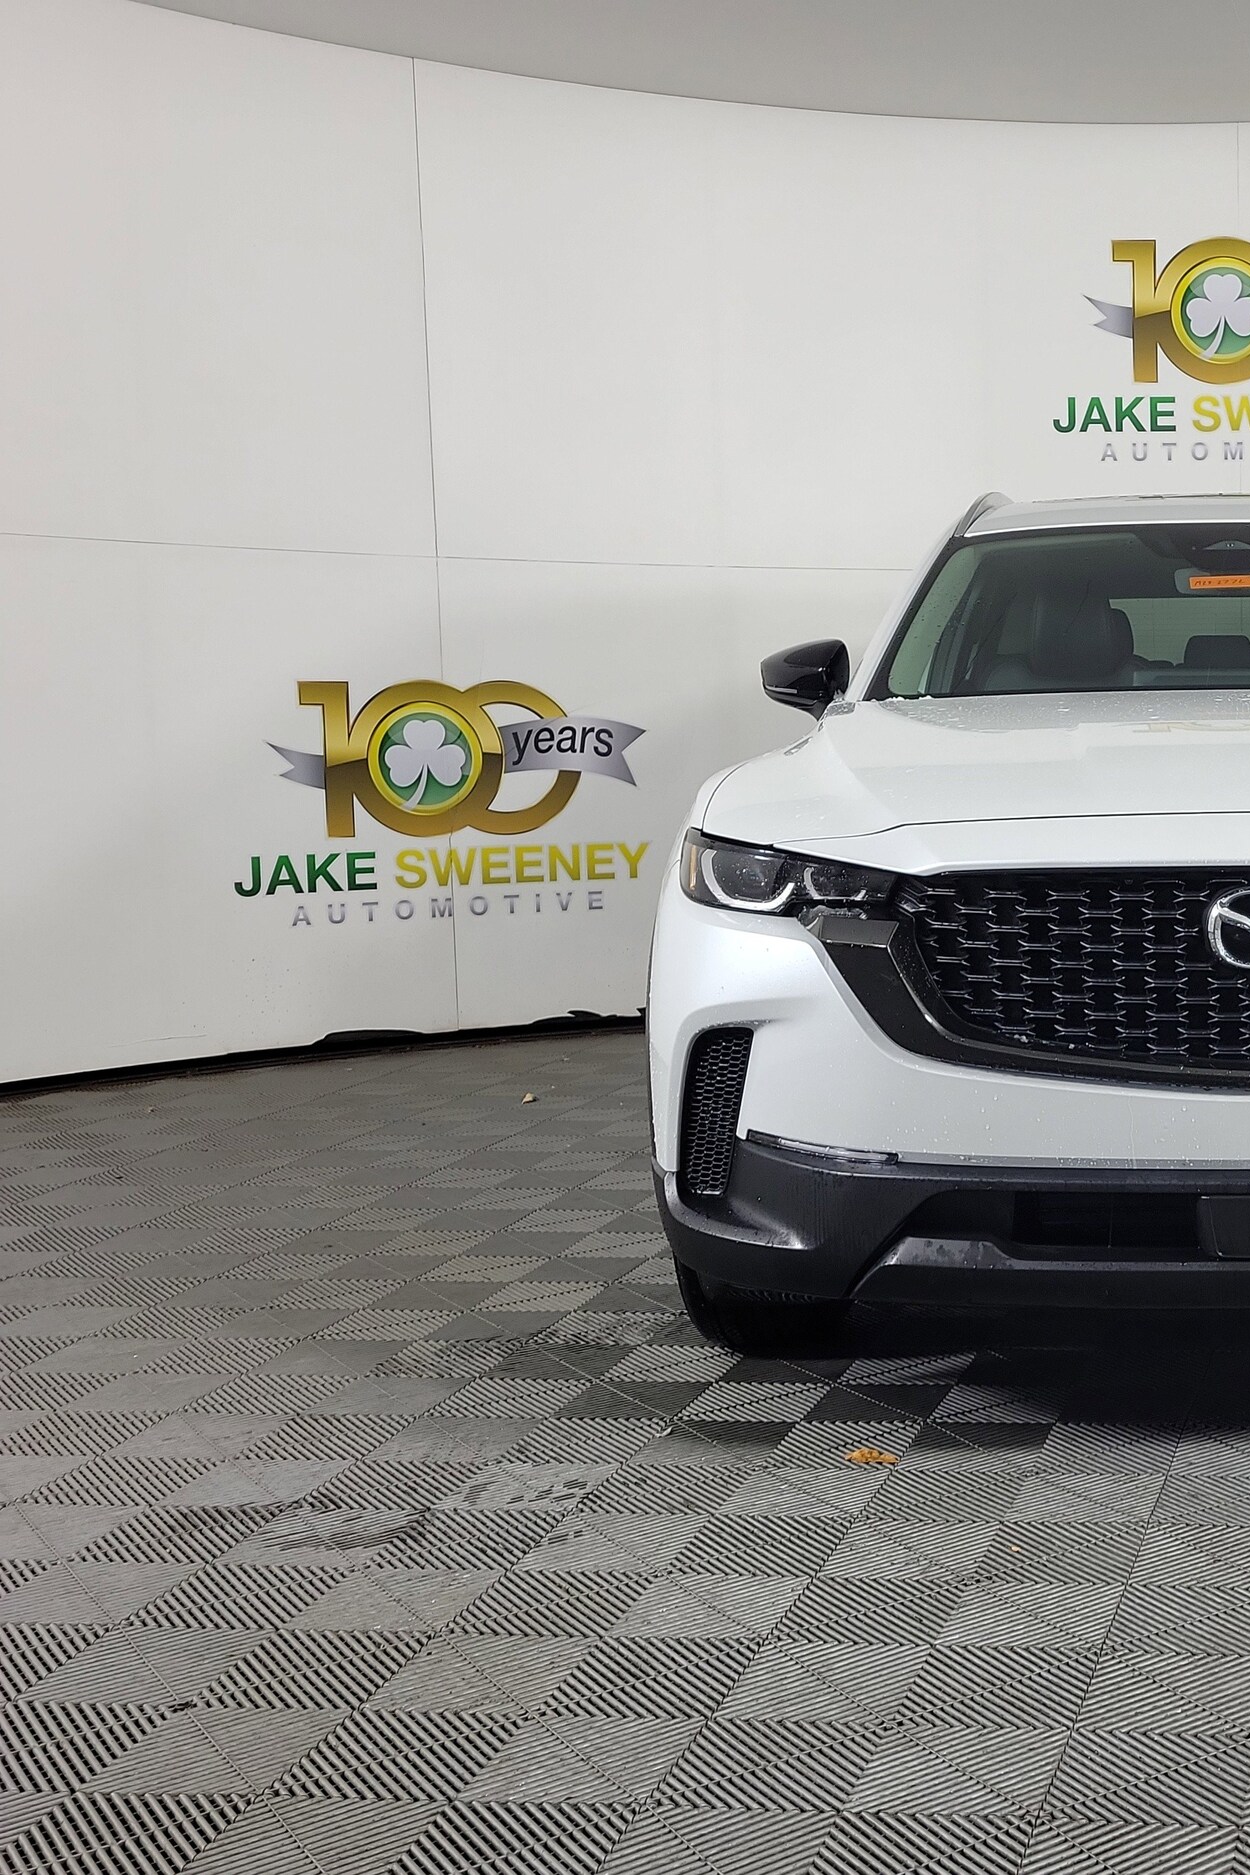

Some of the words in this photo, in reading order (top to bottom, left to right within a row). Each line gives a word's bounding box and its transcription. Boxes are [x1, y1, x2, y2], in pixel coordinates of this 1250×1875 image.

[1053, 397, 1176, 433] JAKE
[297, 680, 582, 838] 100
[511, 725, 613, 765] years
[234, 852, 378, 897] JAKE
[395, 842, 649, 889] SWEENEY
[292, 891, 604, 927] AUTOMOTIVE
